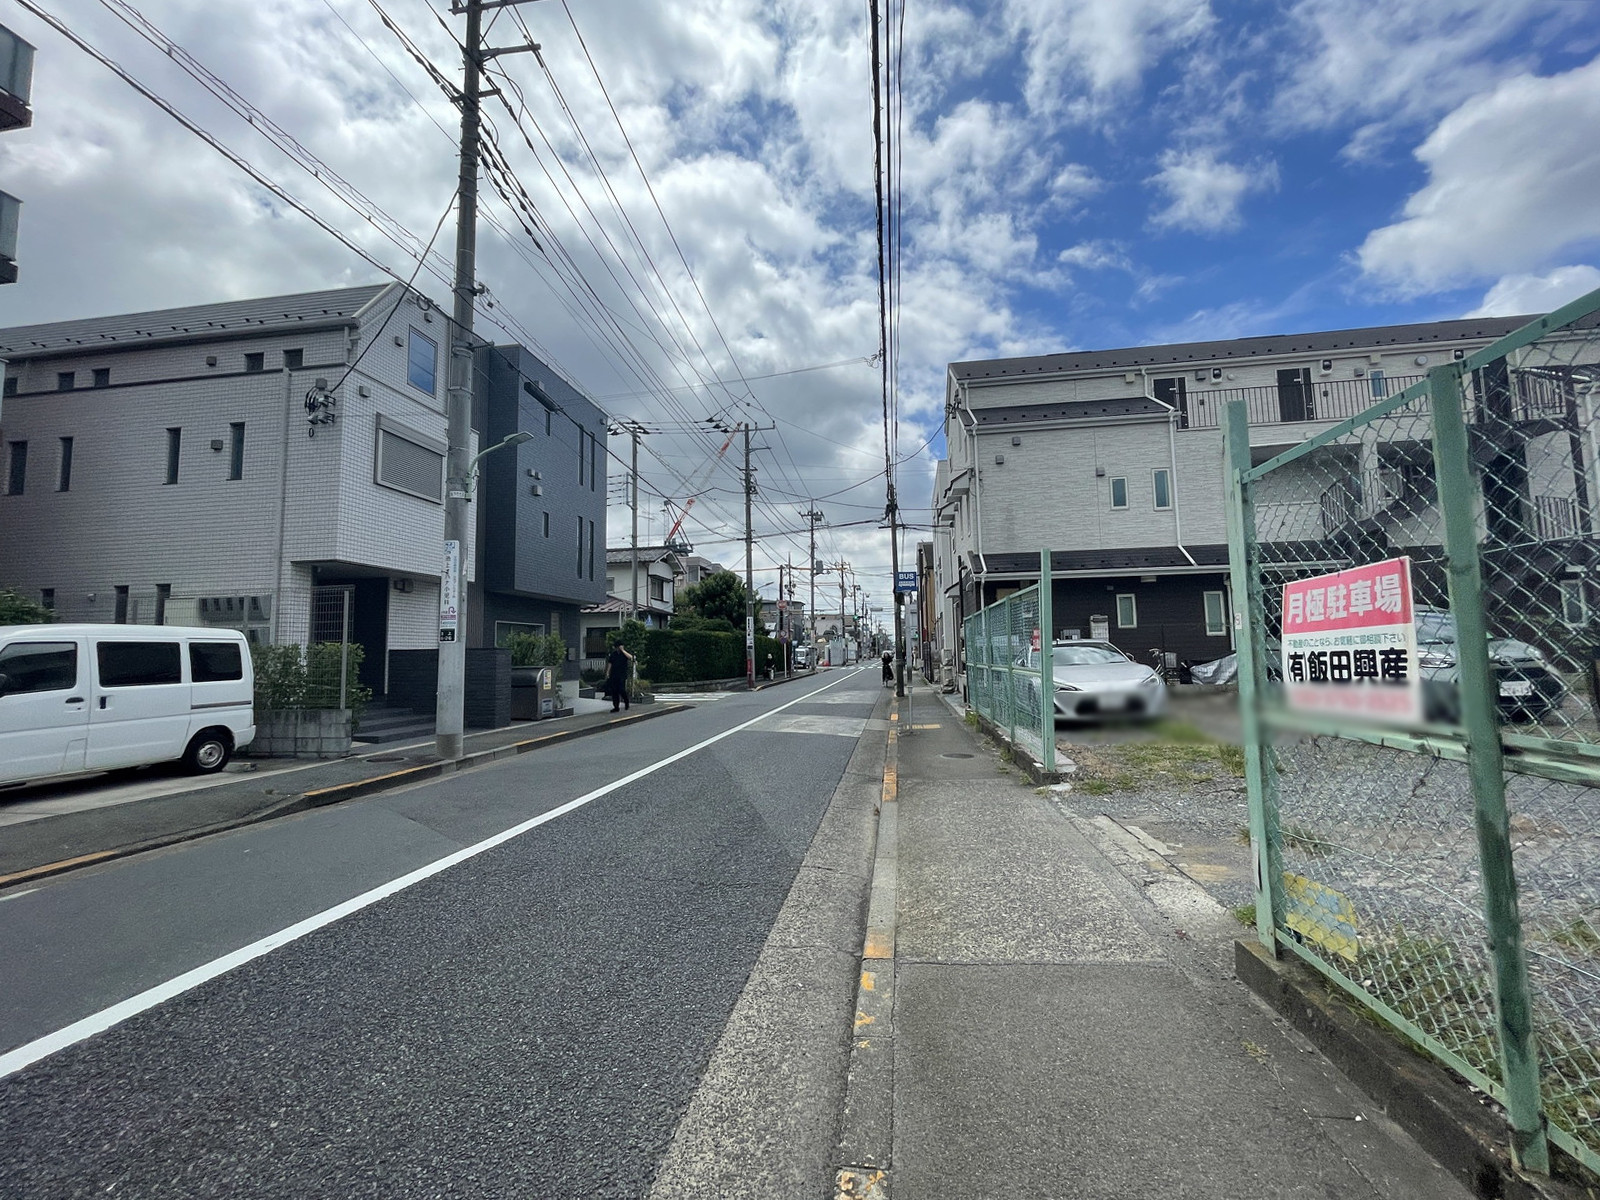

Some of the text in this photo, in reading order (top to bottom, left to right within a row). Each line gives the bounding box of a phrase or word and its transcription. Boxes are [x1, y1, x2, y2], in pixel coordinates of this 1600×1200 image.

[1287, 573, 1402, 624] 月極駐車場
